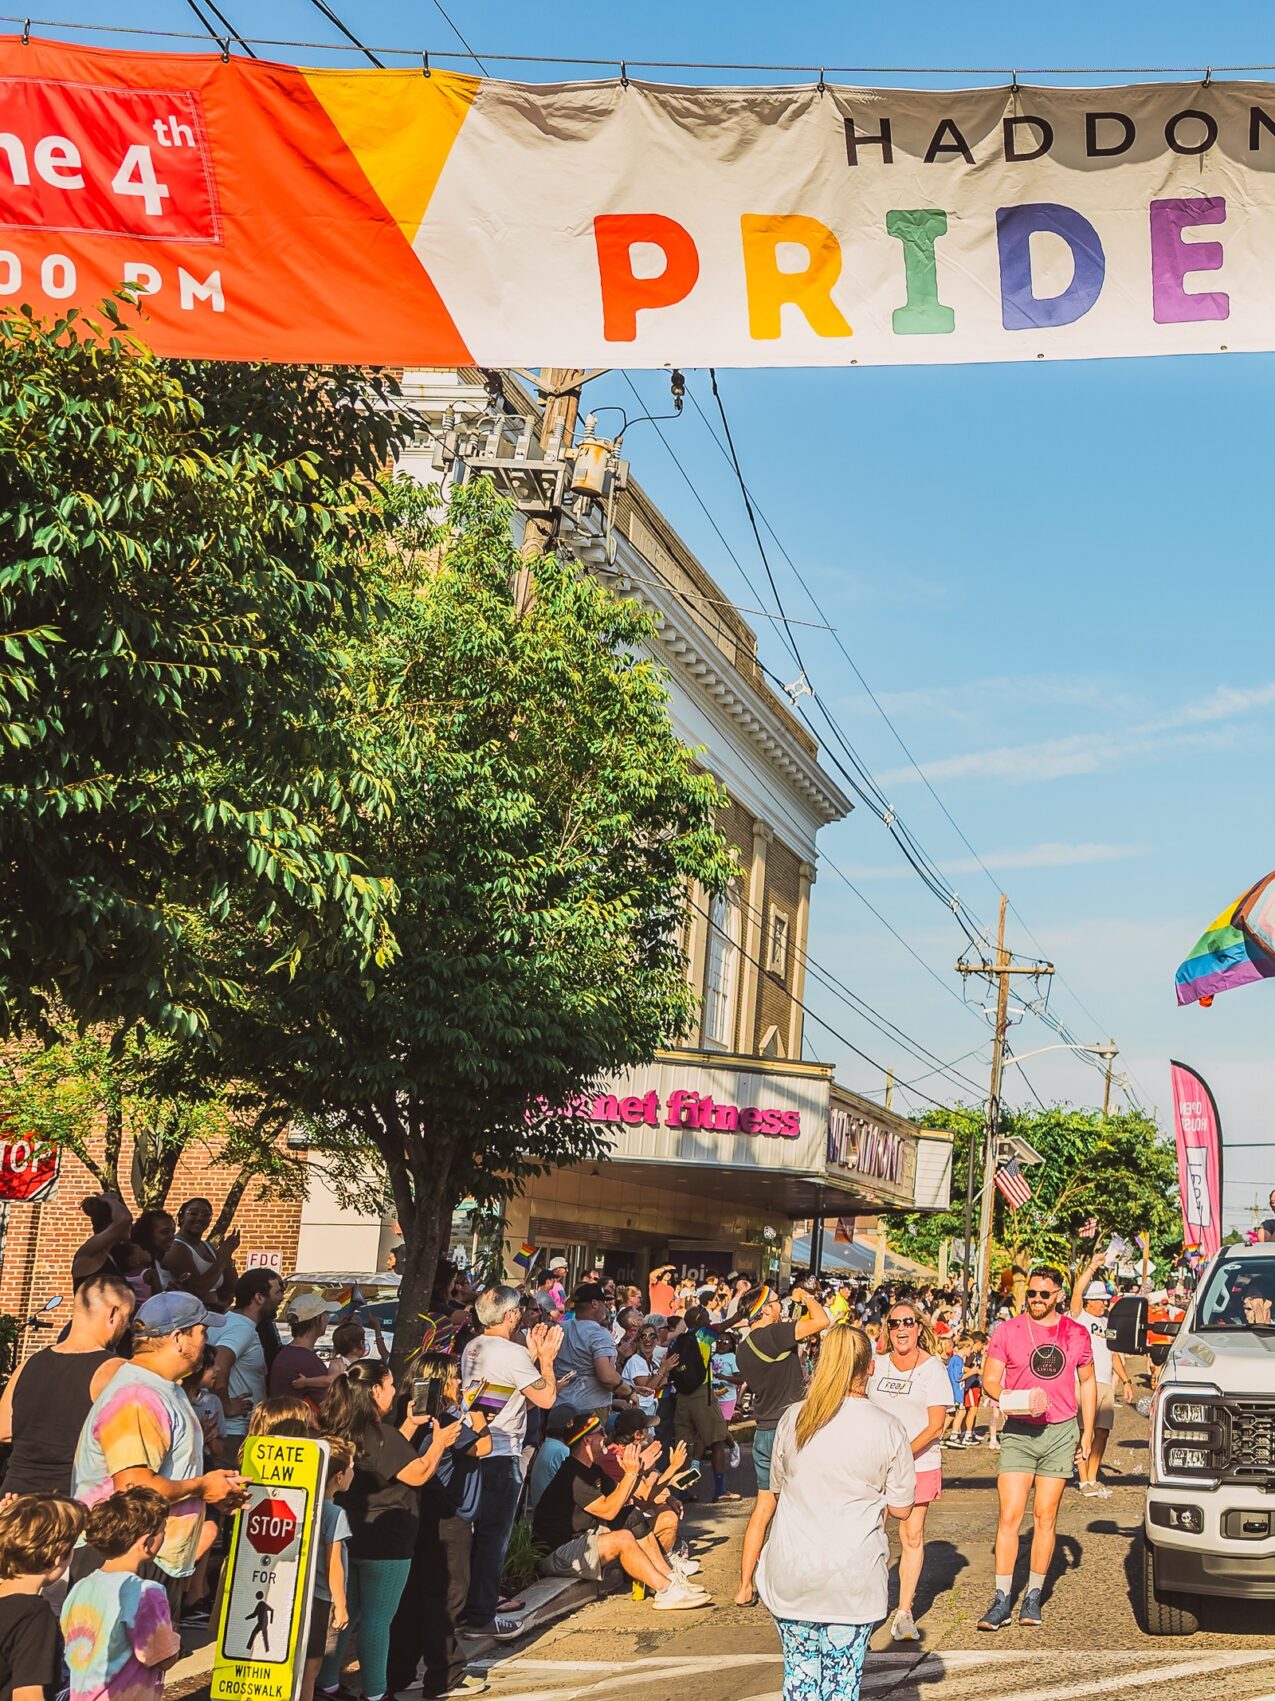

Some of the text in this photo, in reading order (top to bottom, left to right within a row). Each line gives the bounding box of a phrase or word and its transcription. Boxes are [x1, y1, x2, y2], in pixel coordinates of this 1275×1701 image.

[594, 196, 1230, 342] PRIDE
[113, 261, 226, 313] PM
[522, 1087, 800, 1137] net fitness
[250, 1254, 278, 1266] FDC
[256, 1444, 304, 1463] STATE
[261, 1464, 295, 1482] LAW
[250, 1515, 294, 1538] STOP
[252, 1570, 277, 1585] FOR
[235, 1664, 271, 1680] WITHIN
[218, 1680, 283, 1698] CROSSWALK
